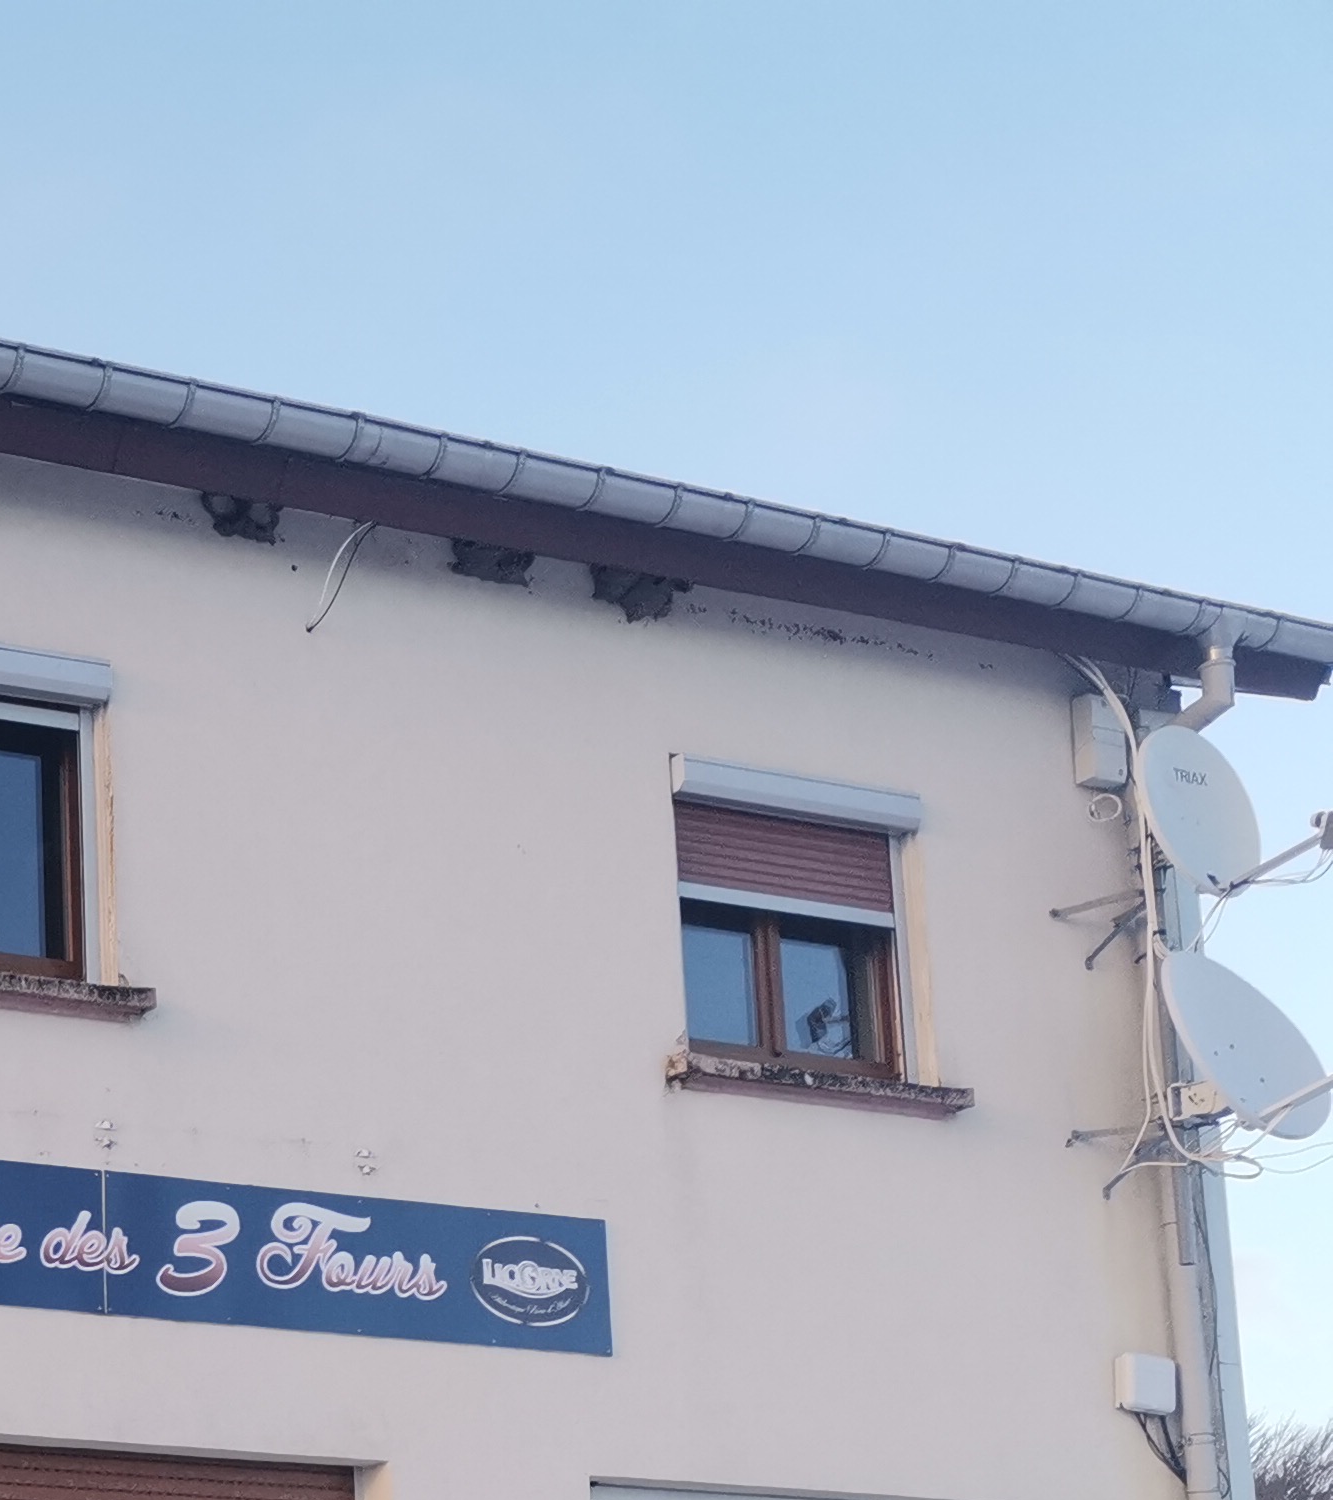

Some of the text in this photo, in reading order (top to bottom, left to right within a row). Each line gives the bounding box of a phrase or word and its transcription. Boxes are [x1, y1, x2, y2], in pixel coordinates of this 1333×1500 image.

[1173, 767, 1208, 786] TRIAX
[39, 1210, 140, 1275] des
[156, 1200, 240, 1297] 3
[256, 1202, 447, 1301] Fours
[482, 1258, 578, 1291] LICORNE
